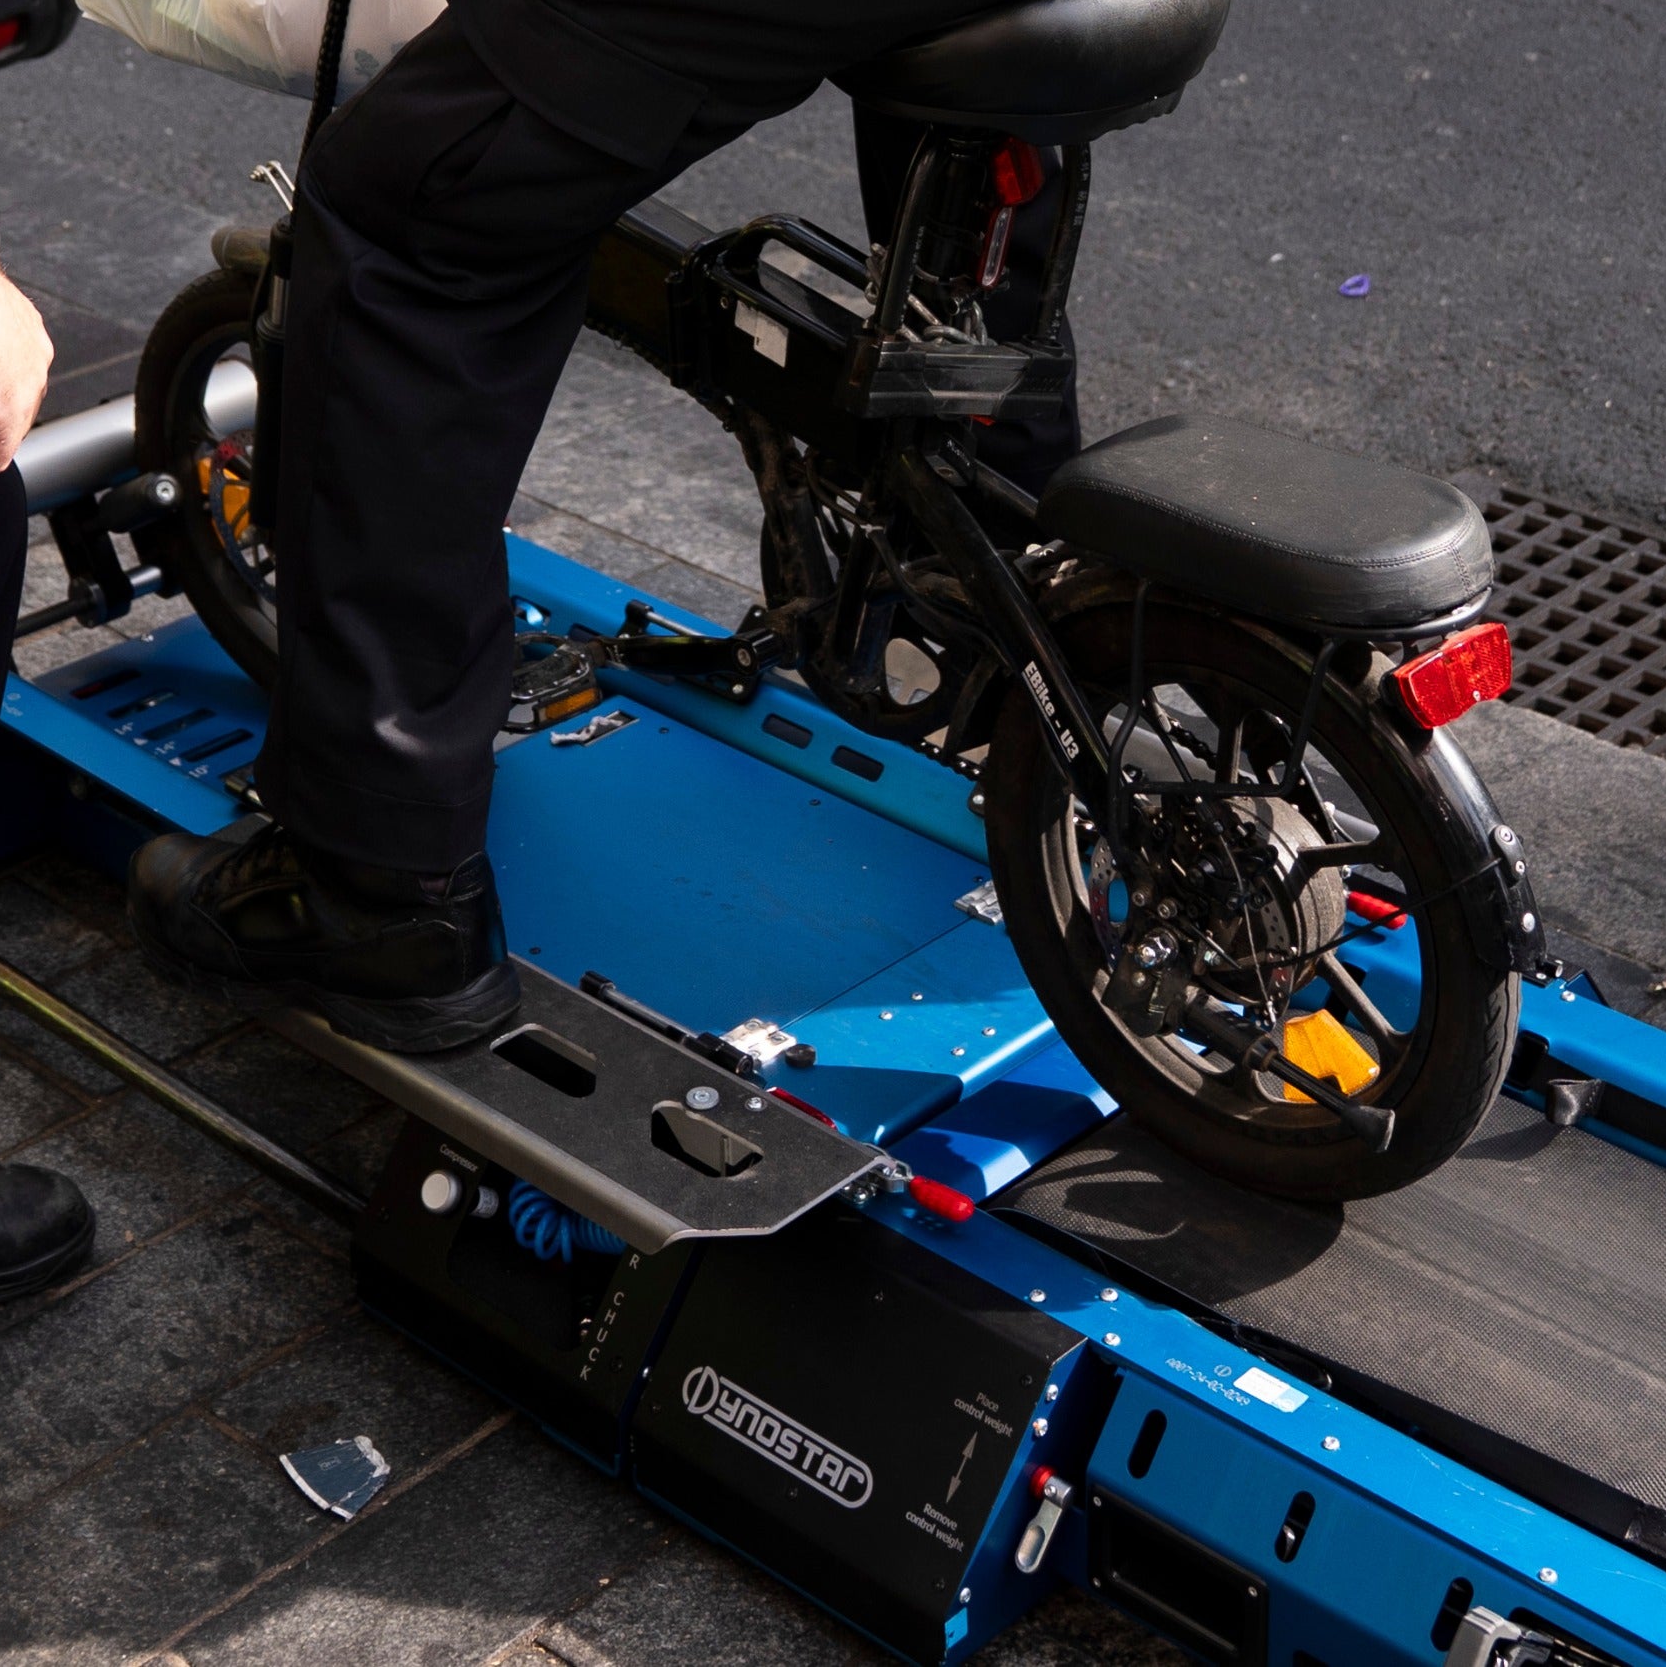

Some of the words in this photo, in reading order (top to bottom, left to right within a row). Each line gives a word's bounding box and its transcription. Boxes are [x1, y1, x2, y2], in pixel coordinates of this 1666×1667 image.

[1024, 660, 1055, 717] EBike
[1059, 728, 1080, 759] U3
[439, 1143, 479, 1173] Compressor
[579, 1291, 625, 1381] CHUCK
[953, 1397, 985, 1421] control
[984, 1413, 1014, 1438] weight
[976, 1391, 1000, 1414] Place
[905, 1510, 937, 1535] control
[935, 1528, 965, 1553] weight
[923, 1502, 958, 1532] Remove
